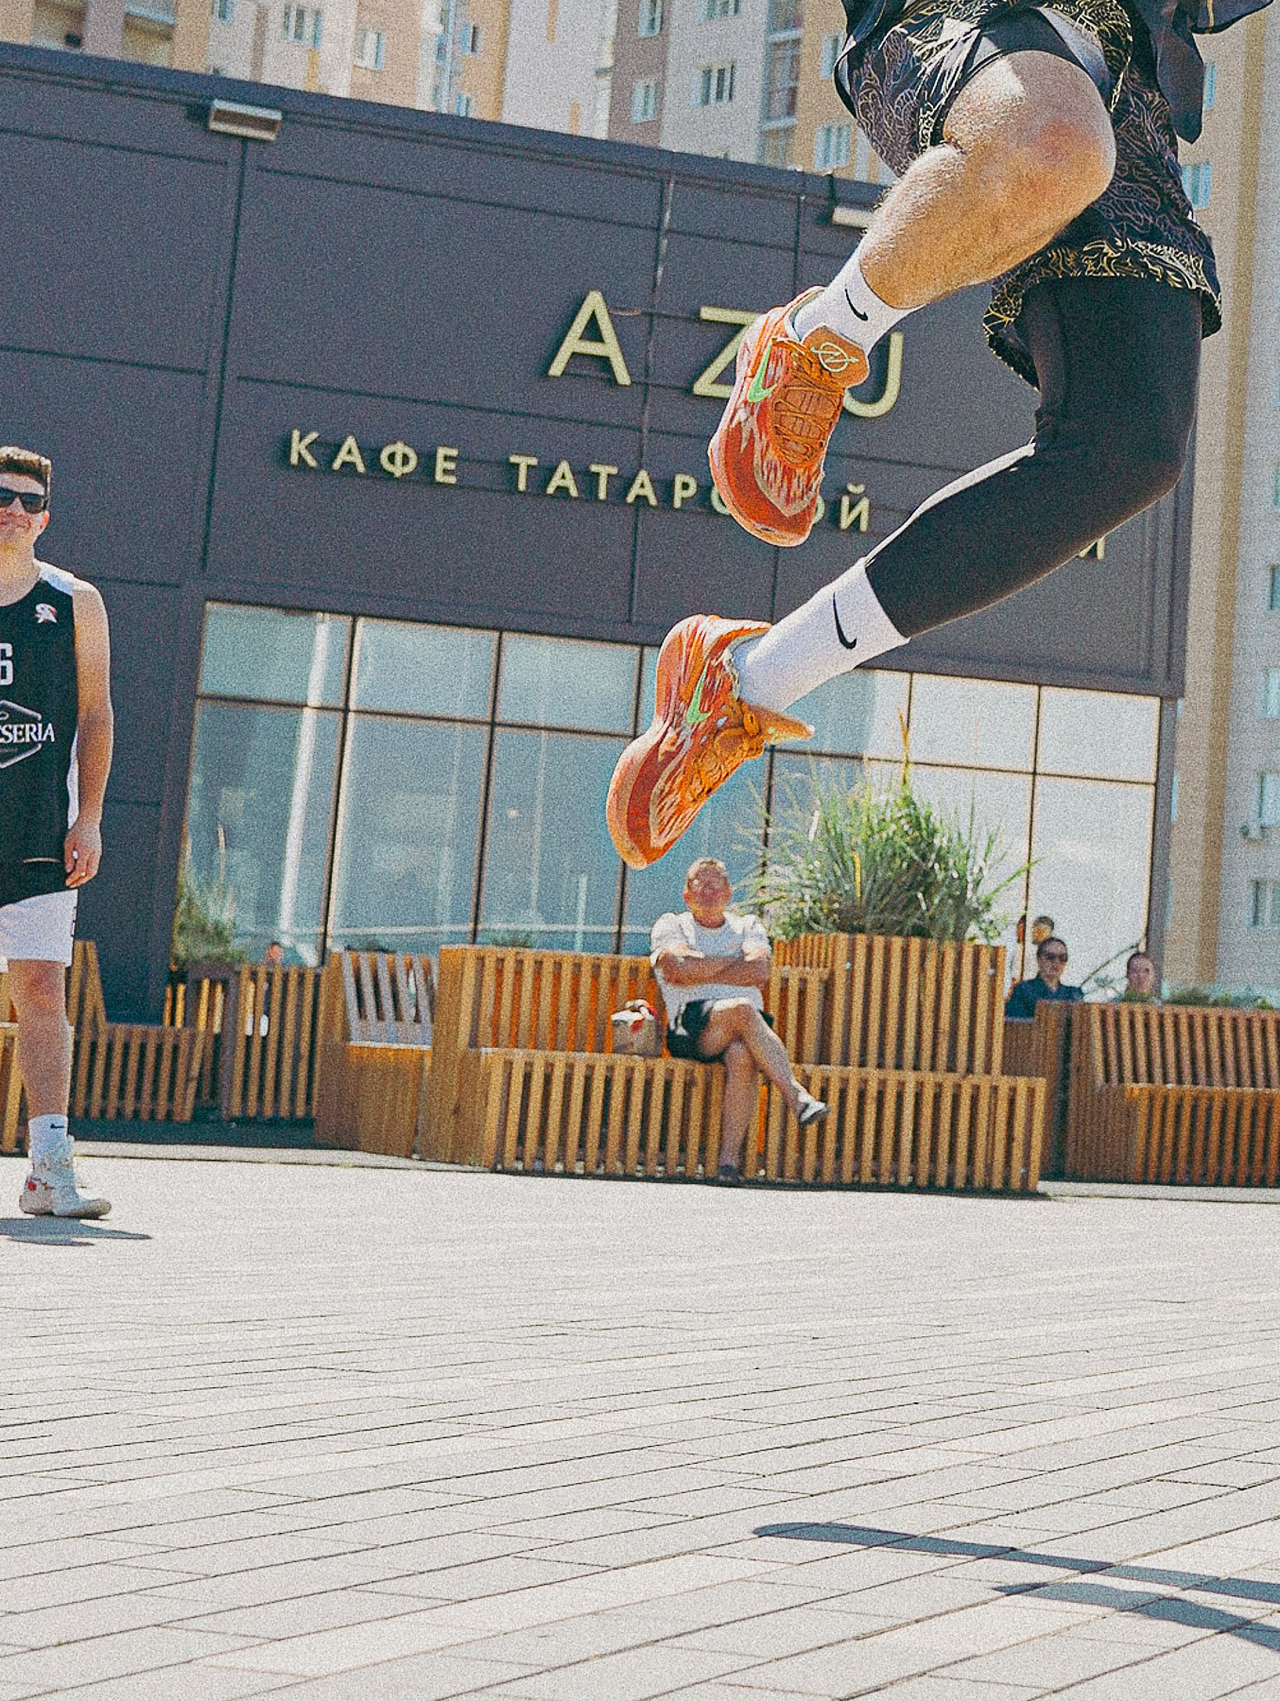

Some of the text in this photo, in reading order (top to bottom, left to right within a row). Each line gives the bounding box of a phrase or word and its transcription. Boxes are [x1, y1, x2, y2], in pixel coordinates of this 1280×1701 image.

[290, 428, 870, 532] КАФЕ ТАТАРЙ
[0, 723, 55, 743] SERIA
